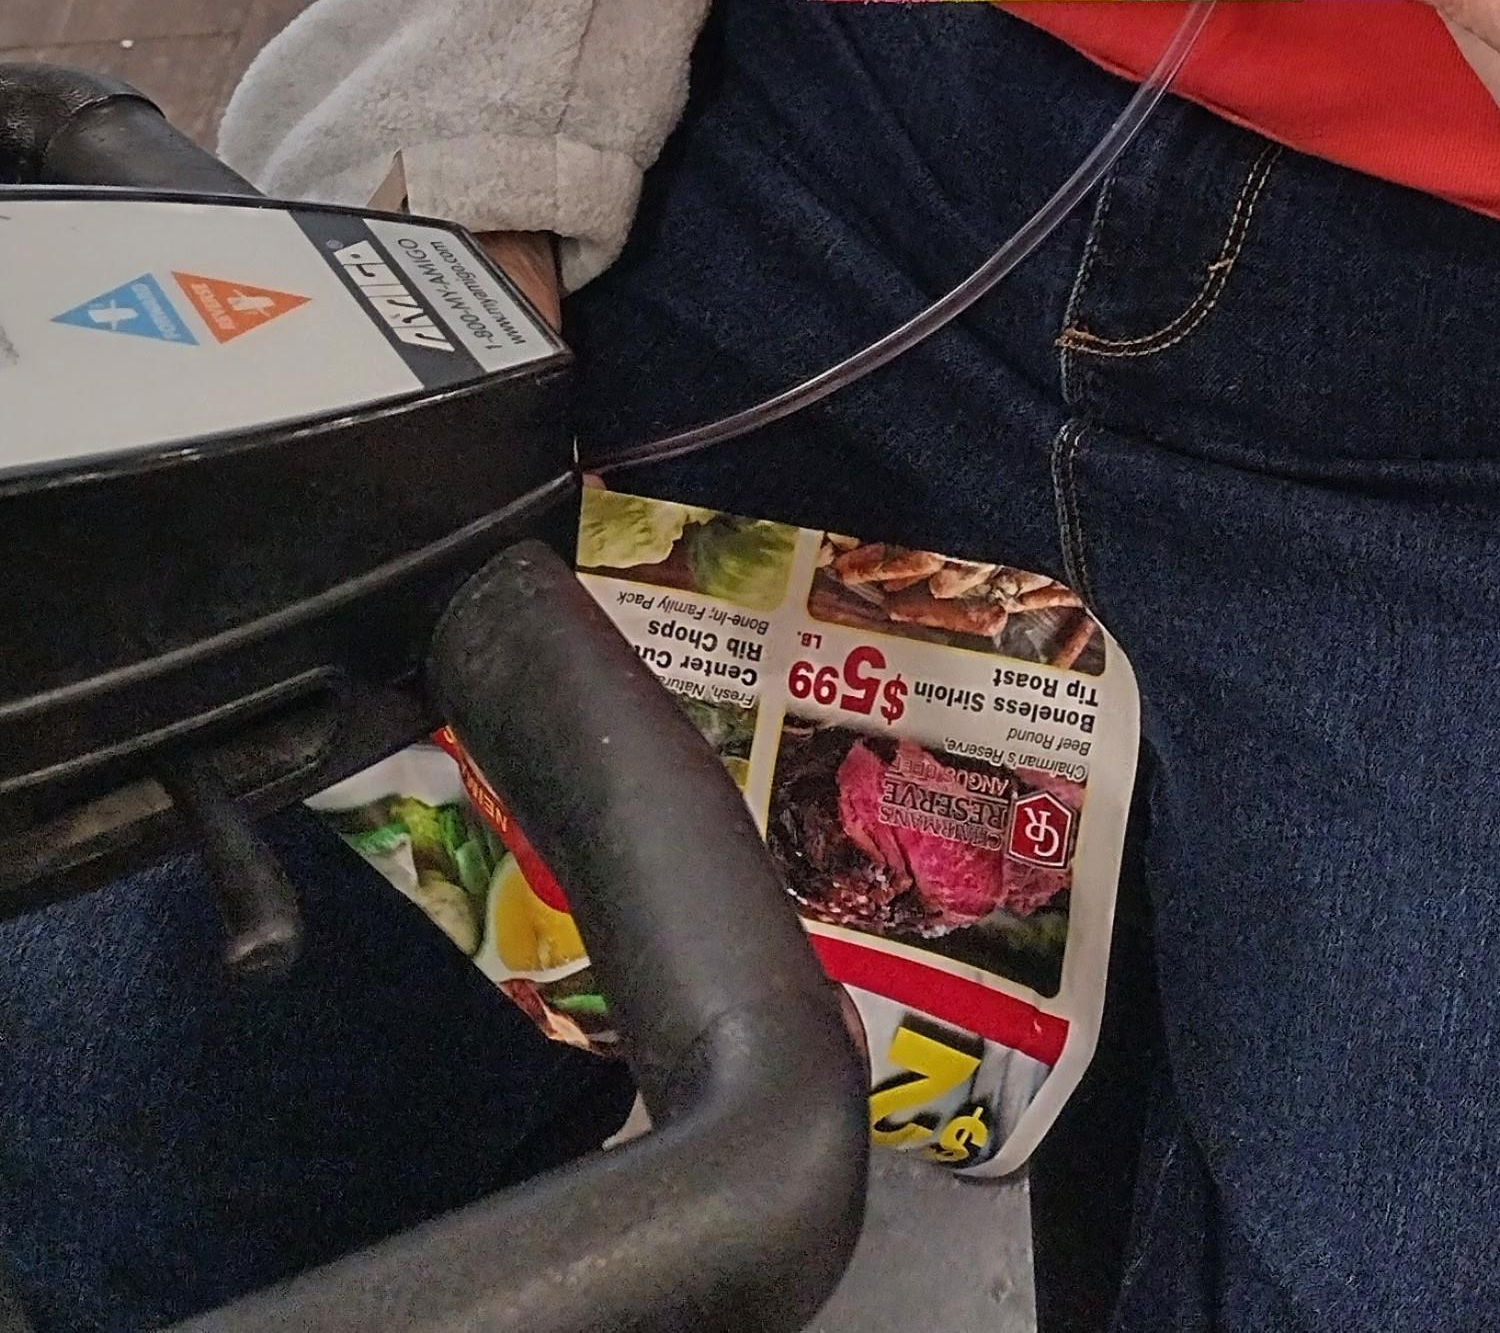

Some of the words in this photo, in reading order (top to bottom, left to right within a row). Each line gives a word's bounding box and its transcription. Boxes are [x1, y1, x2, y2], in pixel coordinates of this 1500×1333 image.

[398, 237, 503, 351] 1-800-MY-AMIGO
[430, 240, 526, 345] www.myamigo.com
[616, 590, 656, 610] Pack
[657, 595, 706, 621] Family
[647, 619, 718, 652] Chops
[709, 607, 770, 636] Bone-In;
[726, 638, 763, 662] Rib
[797, 630, 822, 650] LB.
[680, 655, 758, 687] Center
[993, 668, 1059, 698] Roast
[711, 684, 755, 707] Fresh,
[914, 681, 986, 713] Sirloin
[1067, 684, 1099, 707] Tip
[993, 697, 1096, 734] Boneless
[944, 737, 1005, 765] Reserve,
[1007, 727, 1055, 750] Round
[1056, 735, 1092, 757] Beef
[1008, 752, 1087, 781] Chairman's
[947, 767, 1010, 797] ANGUS
[883, 781, 1009, 831] RESERVE
